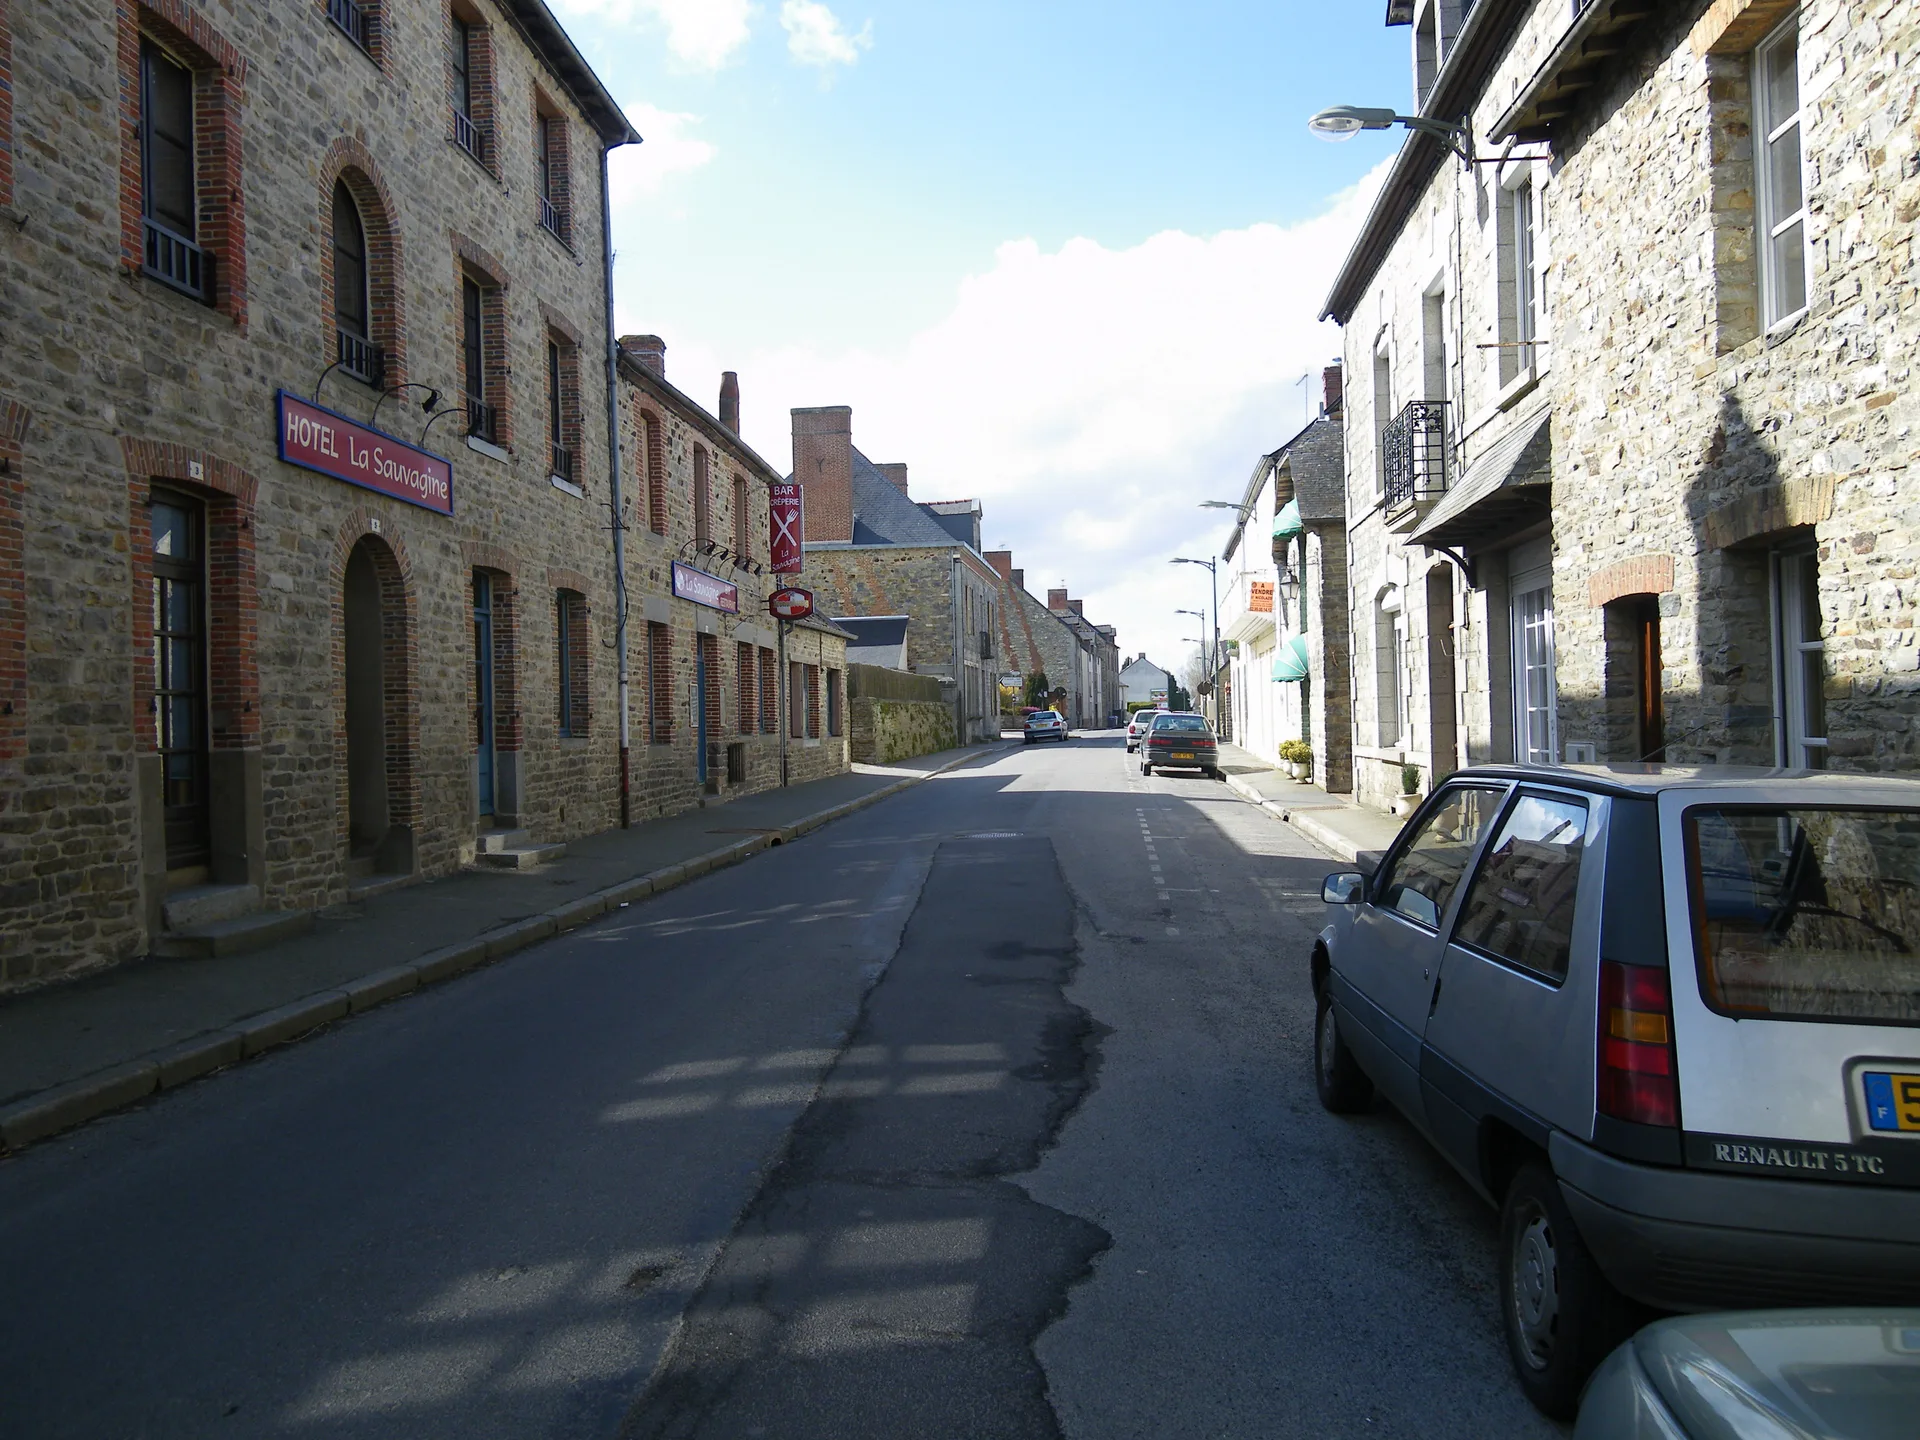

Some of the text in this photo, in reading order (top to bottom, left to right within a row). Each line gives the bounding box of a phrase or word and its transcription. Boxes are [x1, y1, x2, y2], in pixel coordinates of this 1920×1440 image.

[287, 412, 448, 499] HOTEL La Sauvagine
[774, 485, 794, 496] BAR
[781, 549, 789, 558] La
[685, 573, 719, 603] La Sauvagine
[1877, 1105, 1888, 1120] F
[1714, 1143, 1885, 1175] RENAULT 5 TC
